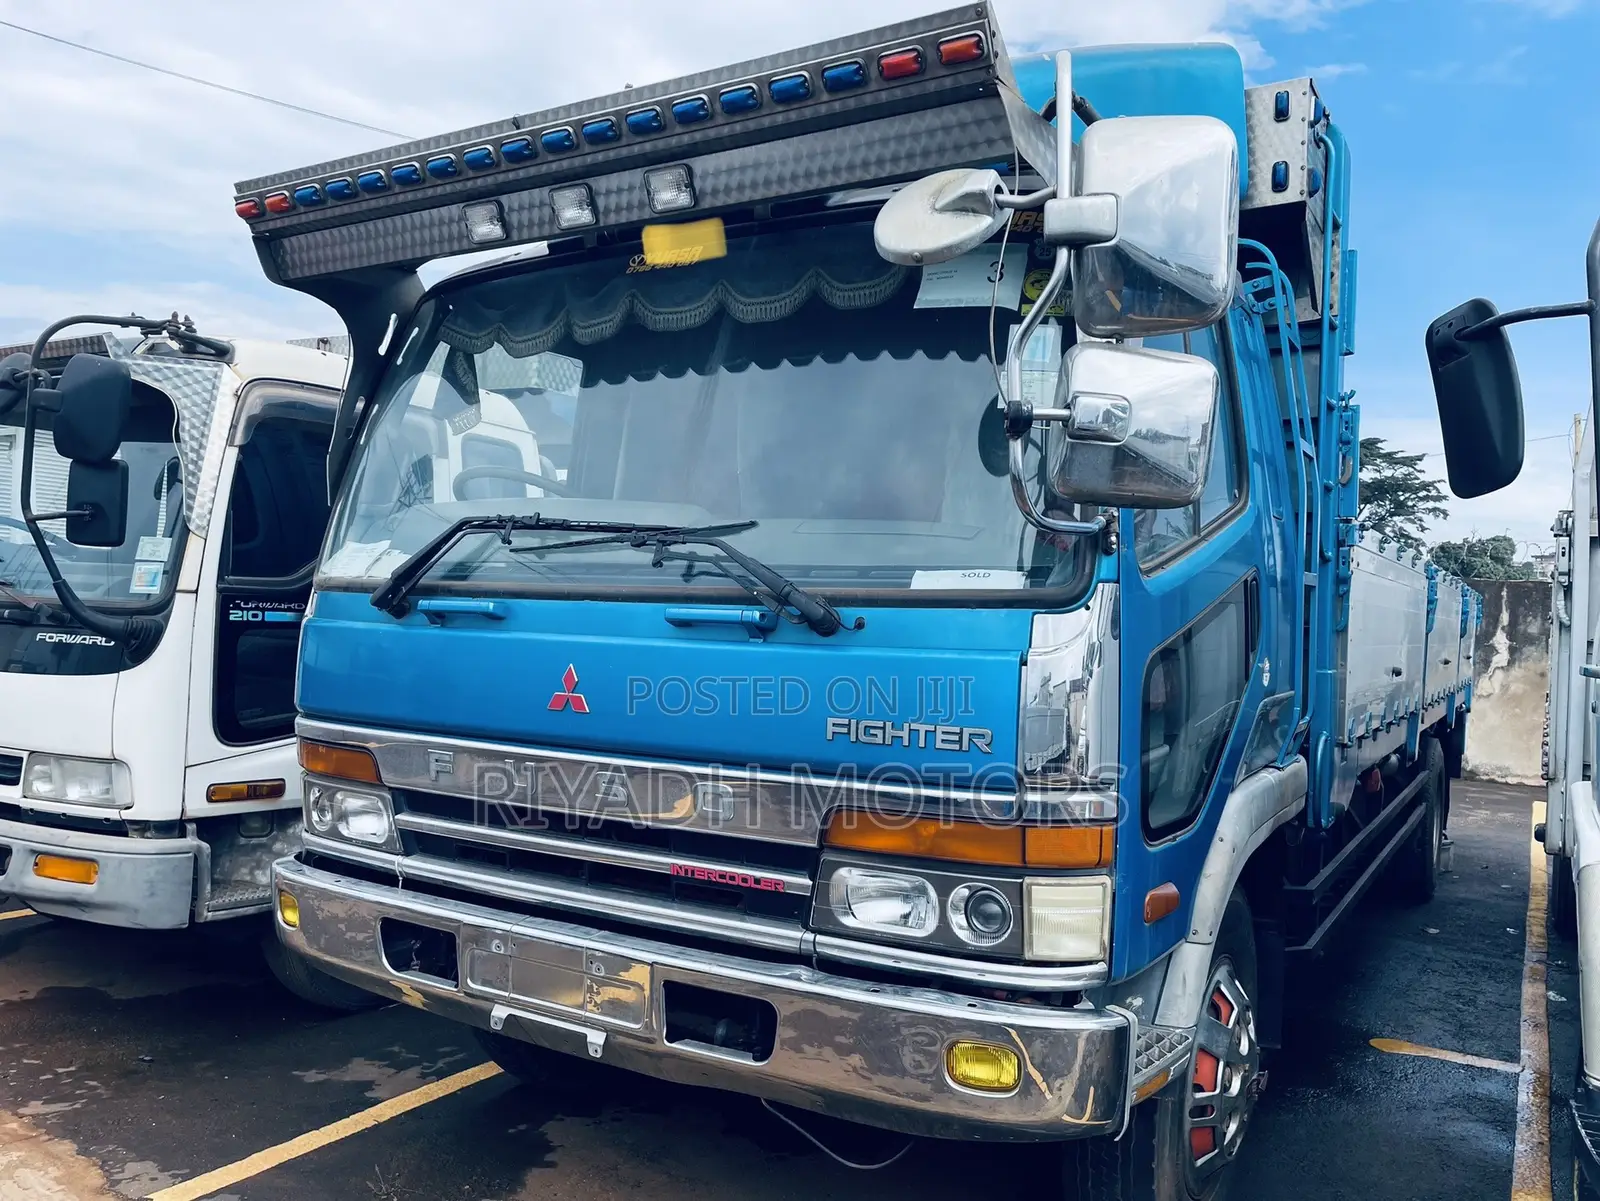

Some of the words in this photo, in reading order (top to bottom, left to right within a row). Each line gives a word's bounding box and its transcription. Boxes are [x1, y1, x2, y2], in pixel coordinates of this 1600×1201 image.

[987, 260, 1005, 284] 3
[229, 610, 263, 621] 210
[825, 717, 993, 754] FIGHTER
[427, 749, 736, 821] FUSO
[669, 863, 785, 893] INTERCOOLER
